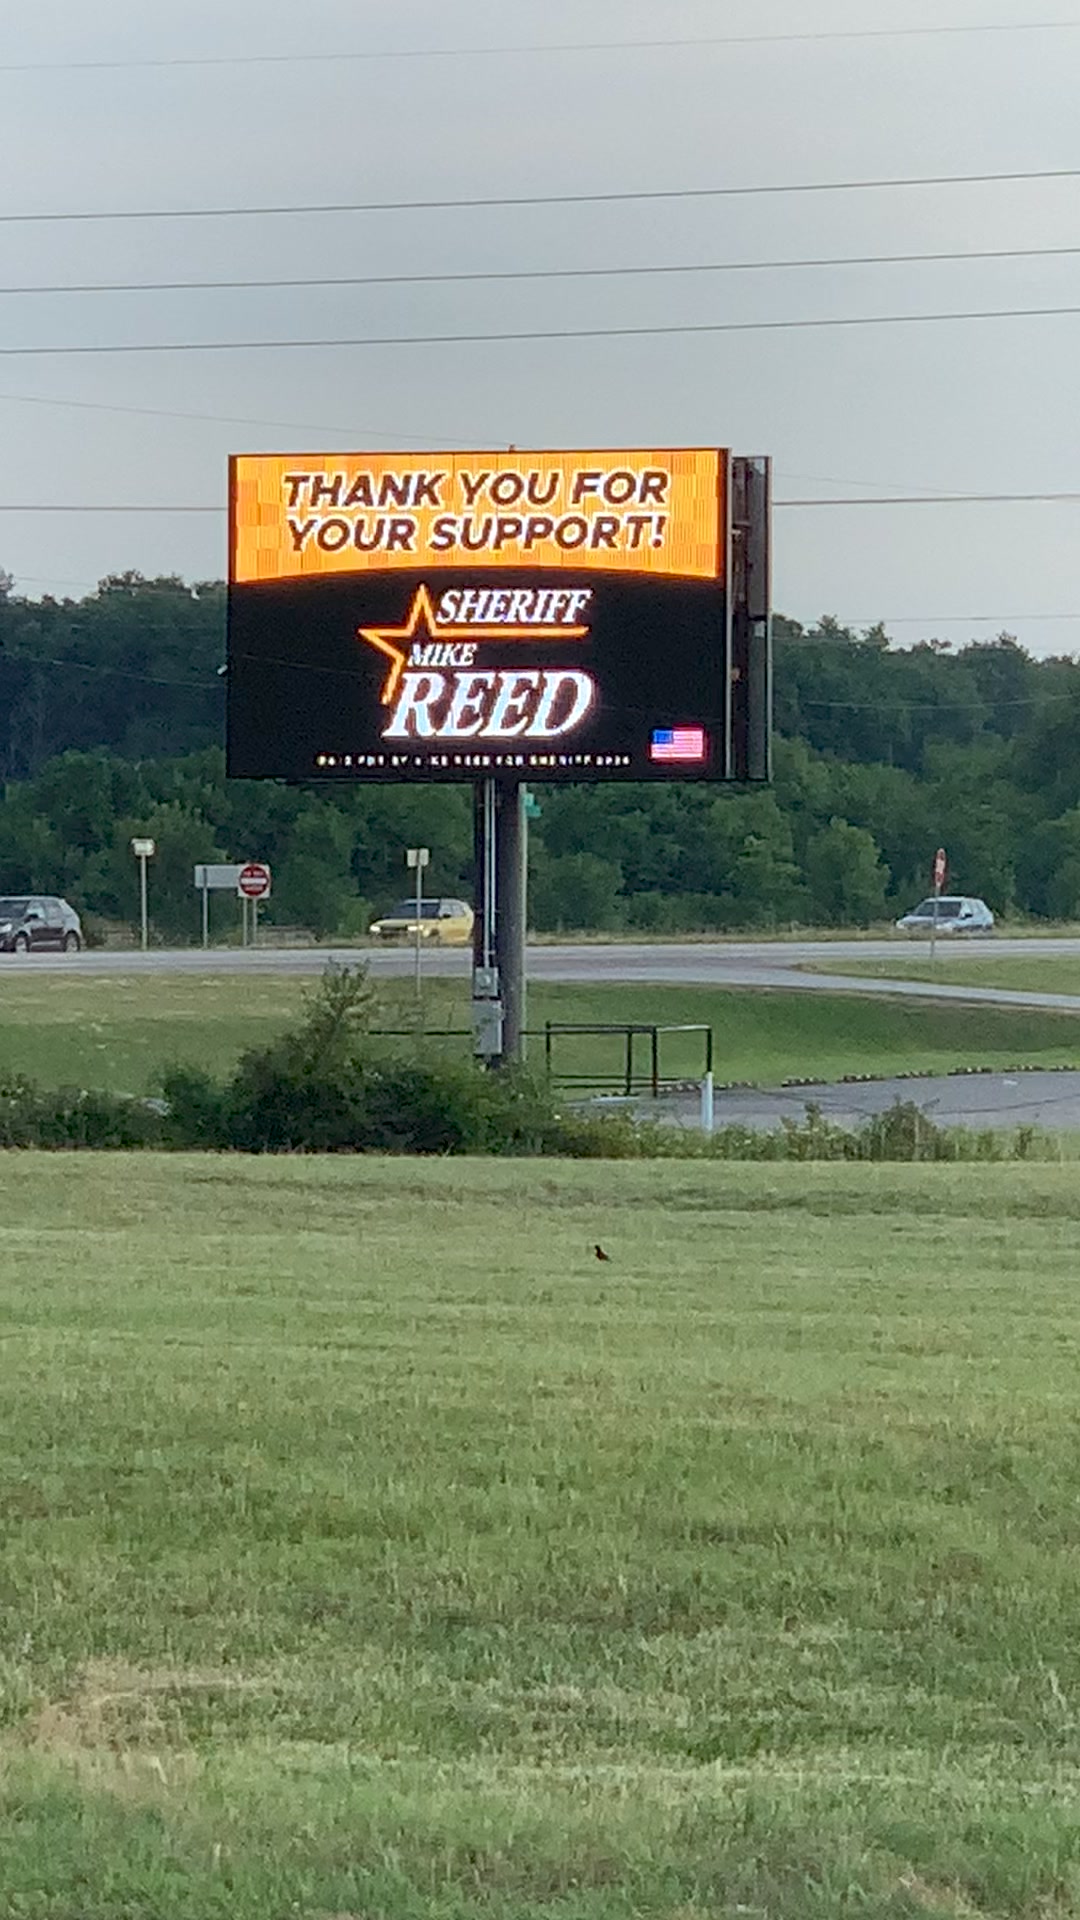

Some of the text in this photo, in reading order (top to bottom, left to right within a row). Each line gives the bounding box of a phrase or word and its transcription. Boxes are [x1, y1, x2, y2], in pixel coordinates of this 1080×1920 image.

[283, 470, 669, 508] THANK YOU FOR
[287, 515, 667, 553] YOUR SUPPORT!
[435, 588, 592, 624] SHERIFF
[406, 642, 478, 667] MIKE
[380, 670, 597, 738] REED
